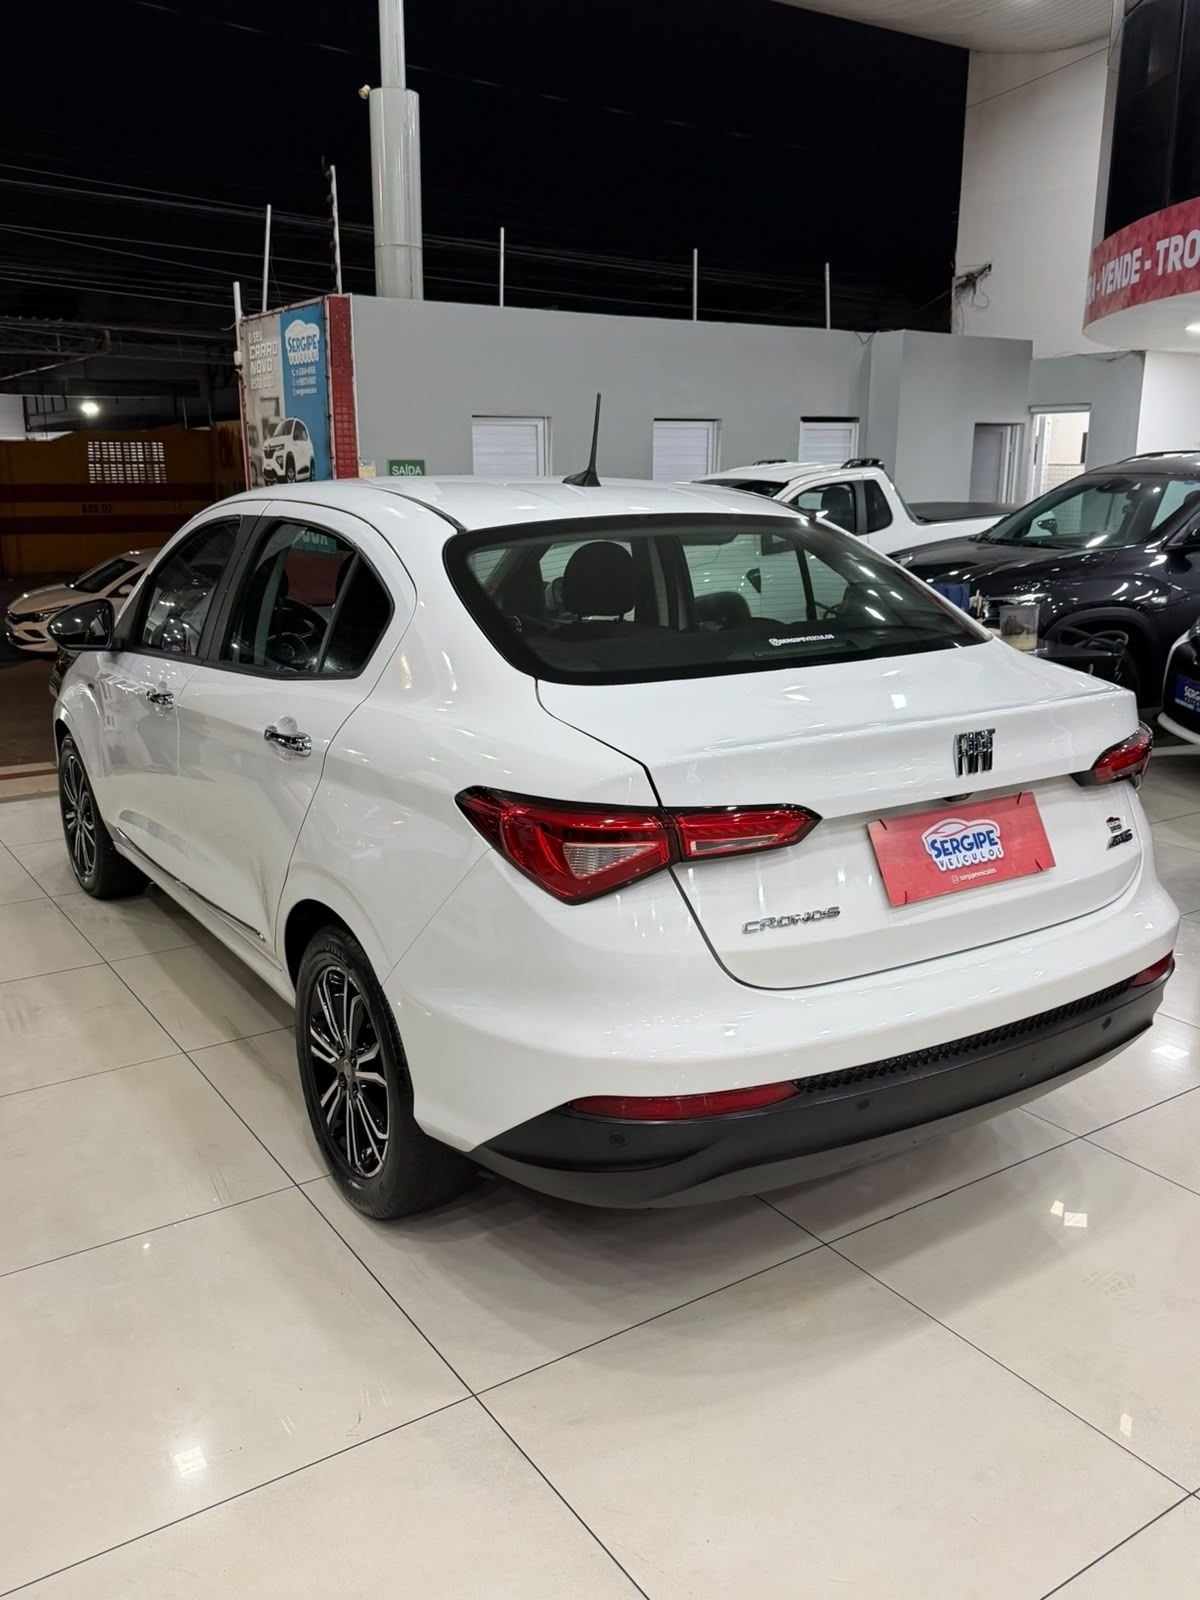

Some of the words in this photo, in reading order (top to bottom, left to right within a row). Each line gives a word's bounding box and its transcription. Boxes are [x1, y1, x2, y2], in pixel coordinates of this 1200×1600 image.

[1101, 247, 1142, 297] VENDE
[249, 340, 278, 360] CARRO
[287, 334, 318, 353] SERGIPE
[250, 358, 273, 375] NOVO
[391, 463, 423, 476] SAÍDA
[953, 728, 996, 778] FIAT
[929, 829, 999, 859] SERGIPE
[742, 906, 841, 934] CRONOS
